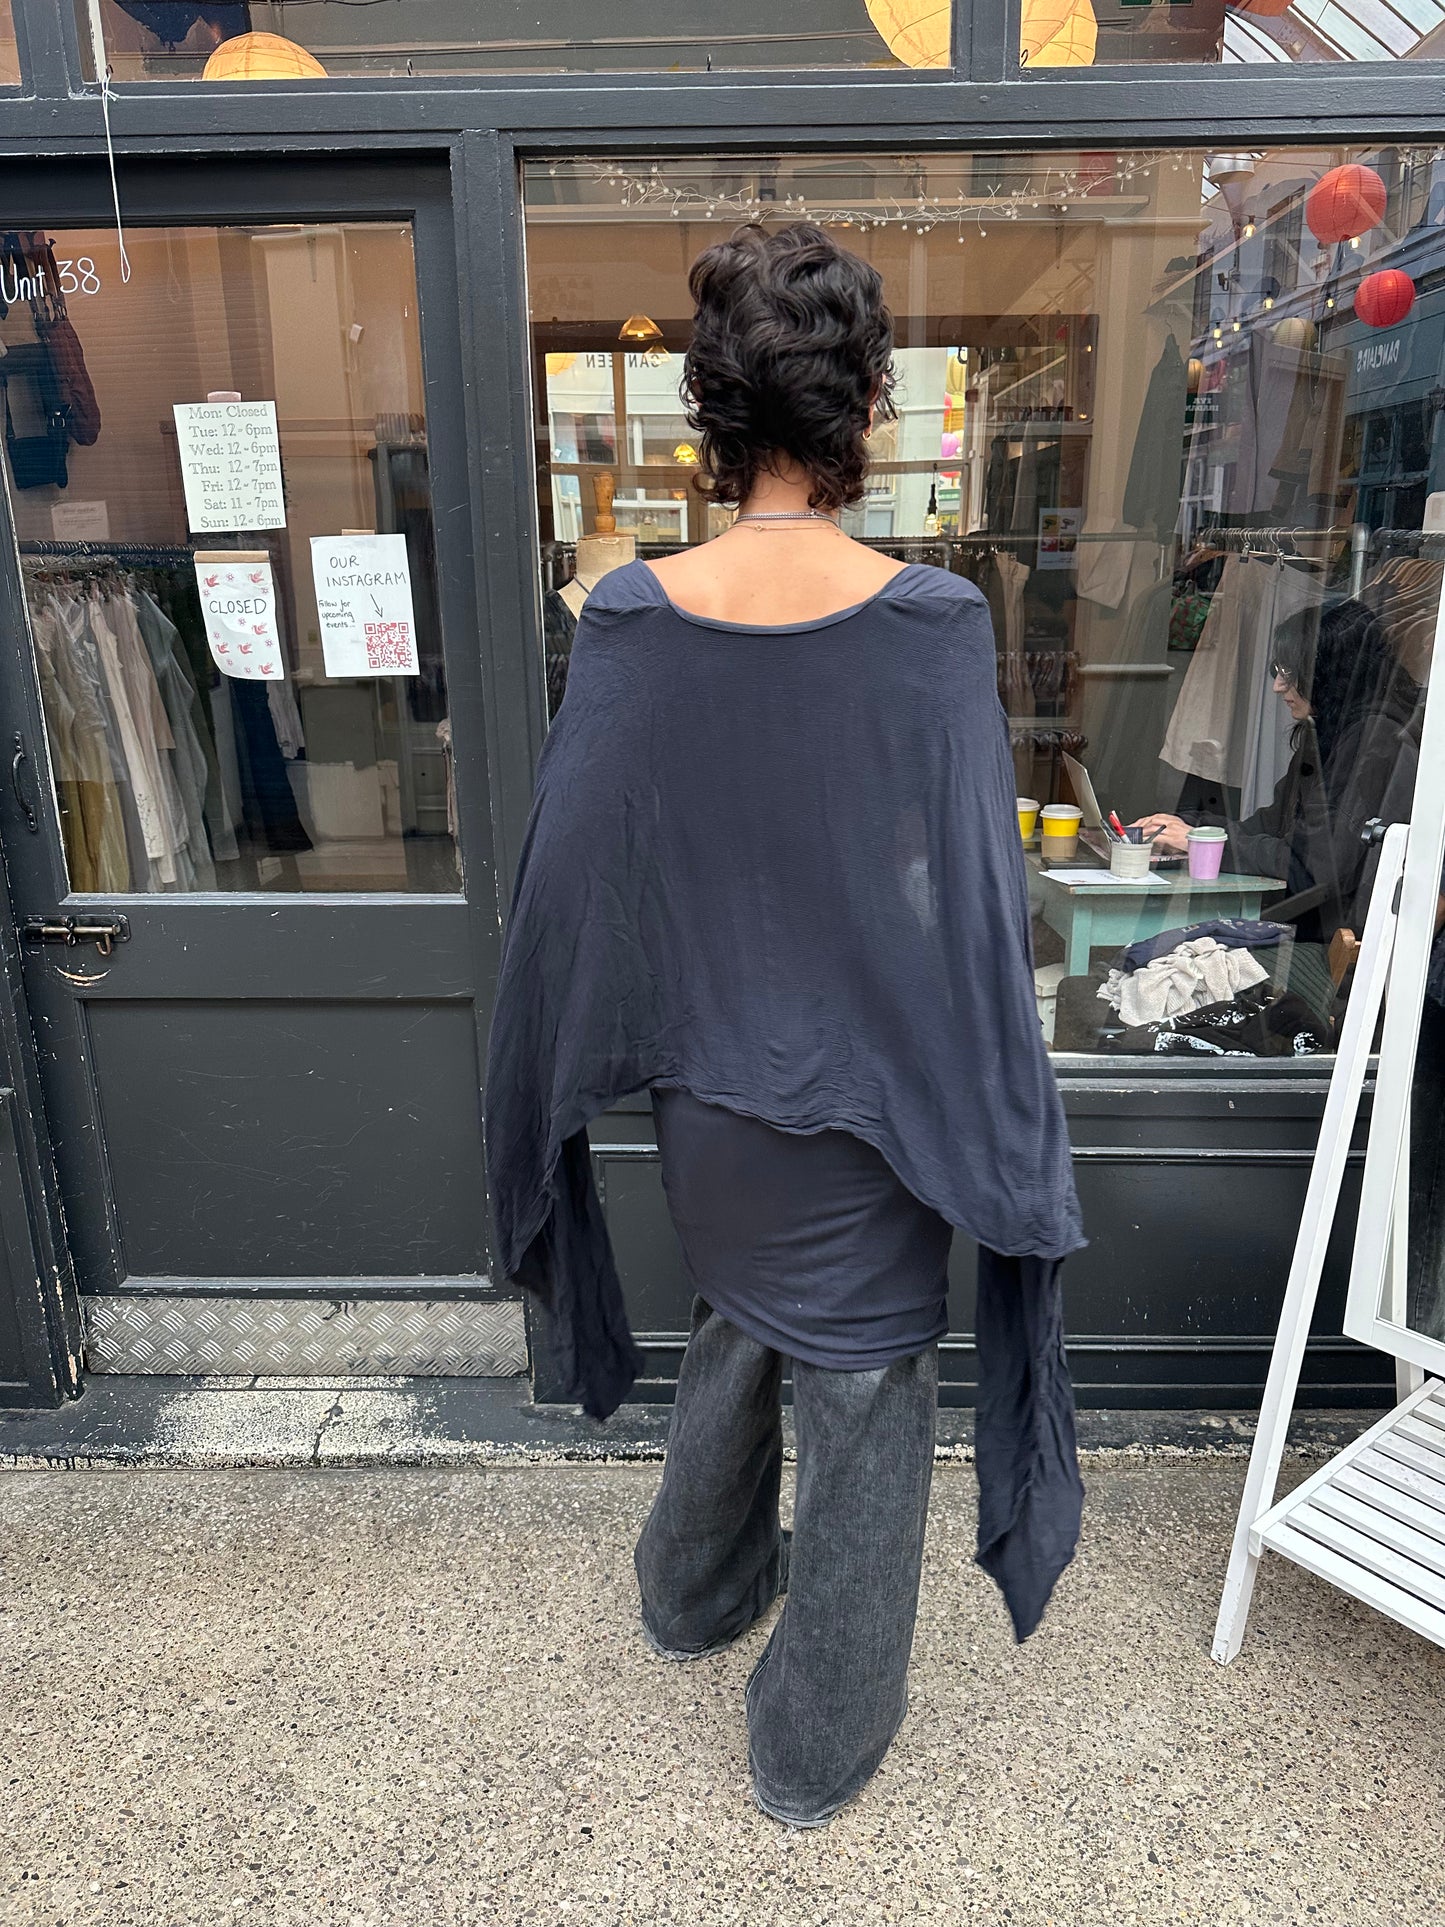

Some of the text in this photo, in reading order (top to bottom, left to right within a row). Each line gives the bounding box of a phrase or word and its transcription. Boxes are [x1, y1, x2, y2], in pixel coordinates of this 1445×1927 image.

[0, 257, 100, 304] Unit 38
[188, 404, 269, 420] Mon: Closed
[188, 425, 219, 438] Tue:
[188, 443, 225, 456] Wed:
[188, 462, 221, 475] Thu:
[201, 480, 224, 493] Fri:
[203, 498, 227, 511] Sat:
[200, 515, 230, 529] Sun:
[329, 554, 360, 569] OUR
[326, 571, 407, 587] INSTAGRAM
[208, 598, 267, 615] CLOSED
[318, 599, 351, 612] Follow for
[321, 611, 355, 623] upcoming
